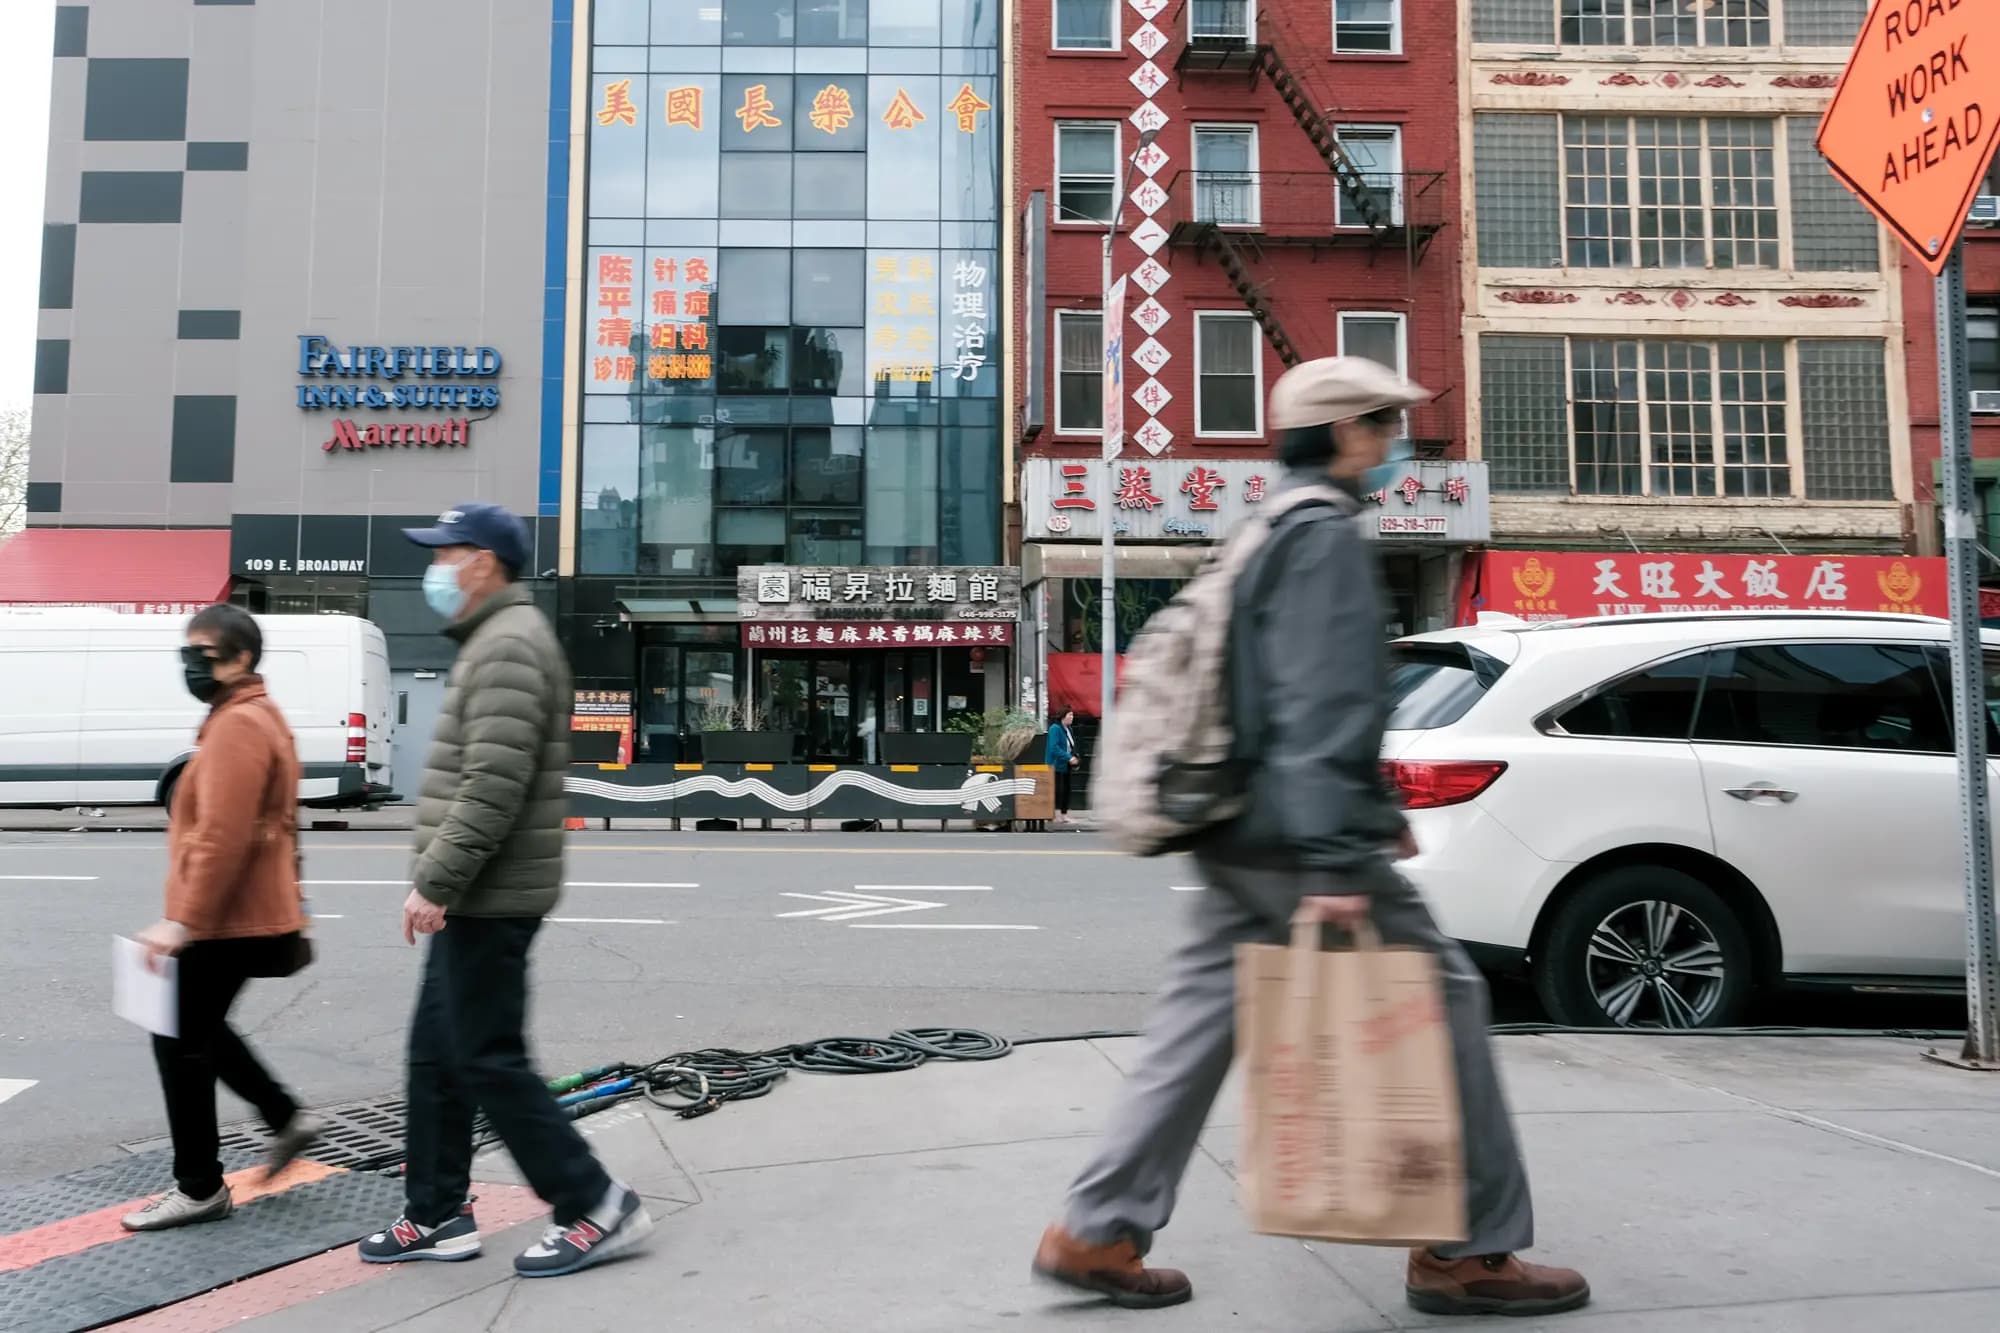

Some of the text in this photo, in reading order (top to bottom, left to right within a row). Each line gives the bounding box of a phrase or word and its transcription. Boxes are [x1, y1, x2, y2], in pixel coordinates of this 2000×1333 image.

[1885, 0, 1963, 52] ROA
[1887, 33, 1969, 118] WORK
[597, 79, 990, 133] 美國長樂公會
[1881, 103, 1982, 193] AHEAD
[654, 256, 709, 283] 针灸
[652, 289, 710, 316] 痛症
[651, 322, 708, 350] 妇科
[951, 260, 987, 381] 物理治疗
[594, 355, 636, 382] 诊所
[296, 384, 499, 409] INN & SUITES
[321, 417, 469, 451] Marriott
[1052, 464, 1226, 511] 三蒸堂
[245, 559, 365, 571] 109 E. BROADWAY
[1592, 559, 1848, 600] 天旺大飯店
[392, 1219, 420, 1247] N
[564, 1219, 605, 1252] N
